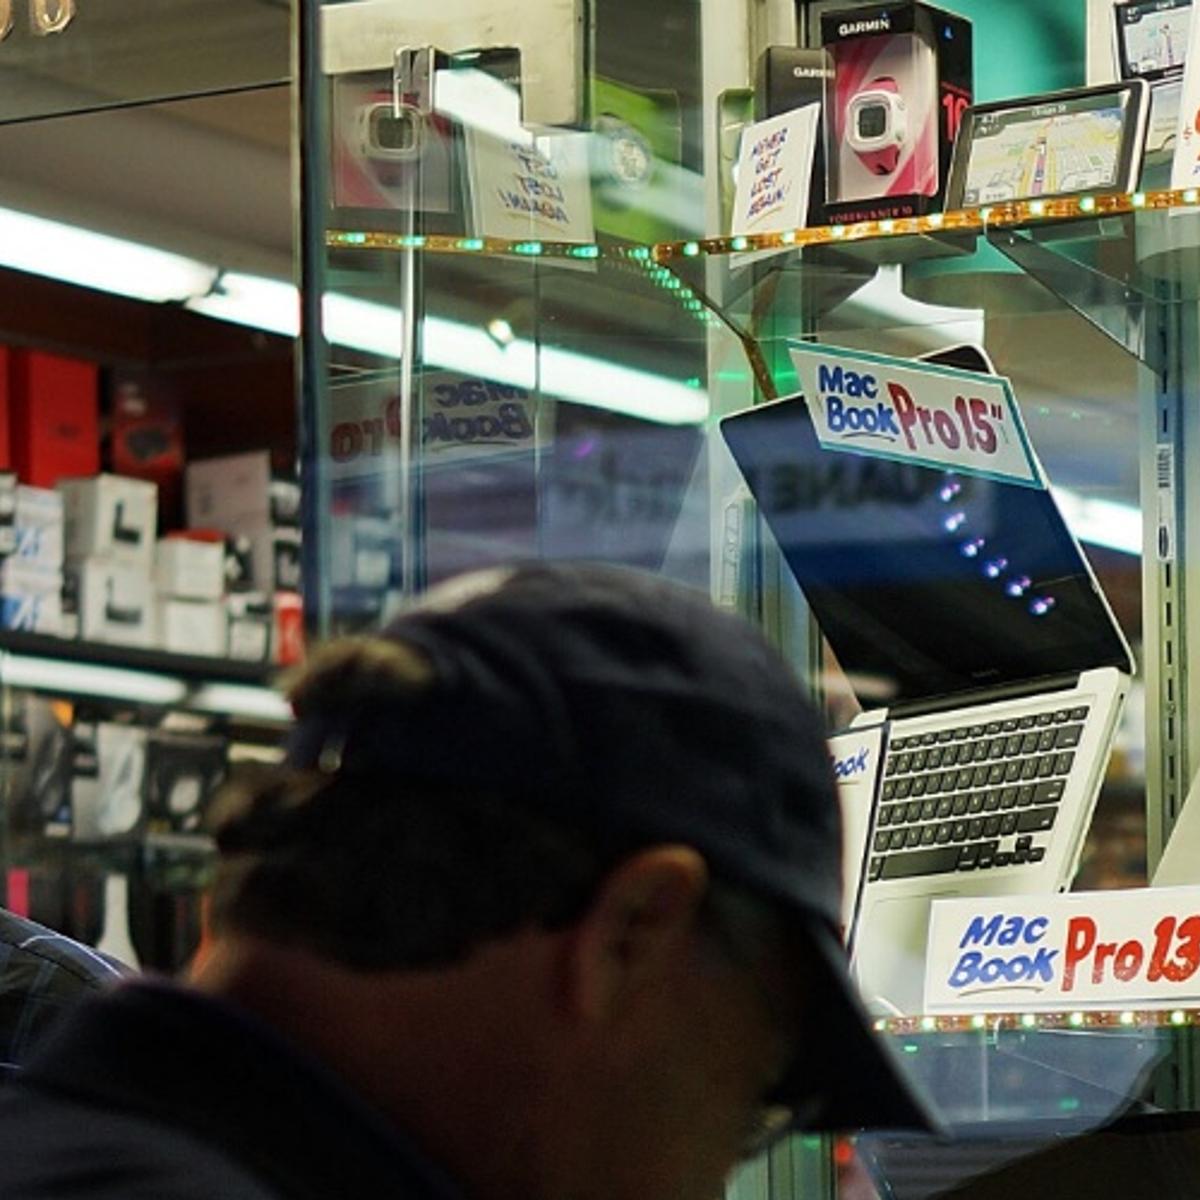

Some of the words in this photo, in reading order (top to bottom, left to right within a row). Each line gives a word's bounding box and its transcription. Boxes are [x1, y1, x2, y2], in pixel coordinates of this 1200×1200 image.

[839, 19, 890, 36] GARMIN
[818, 364, 878, 399] Mac
[827, 396, 899, 435] Book
[959, 914, 1049, 949] Mac
